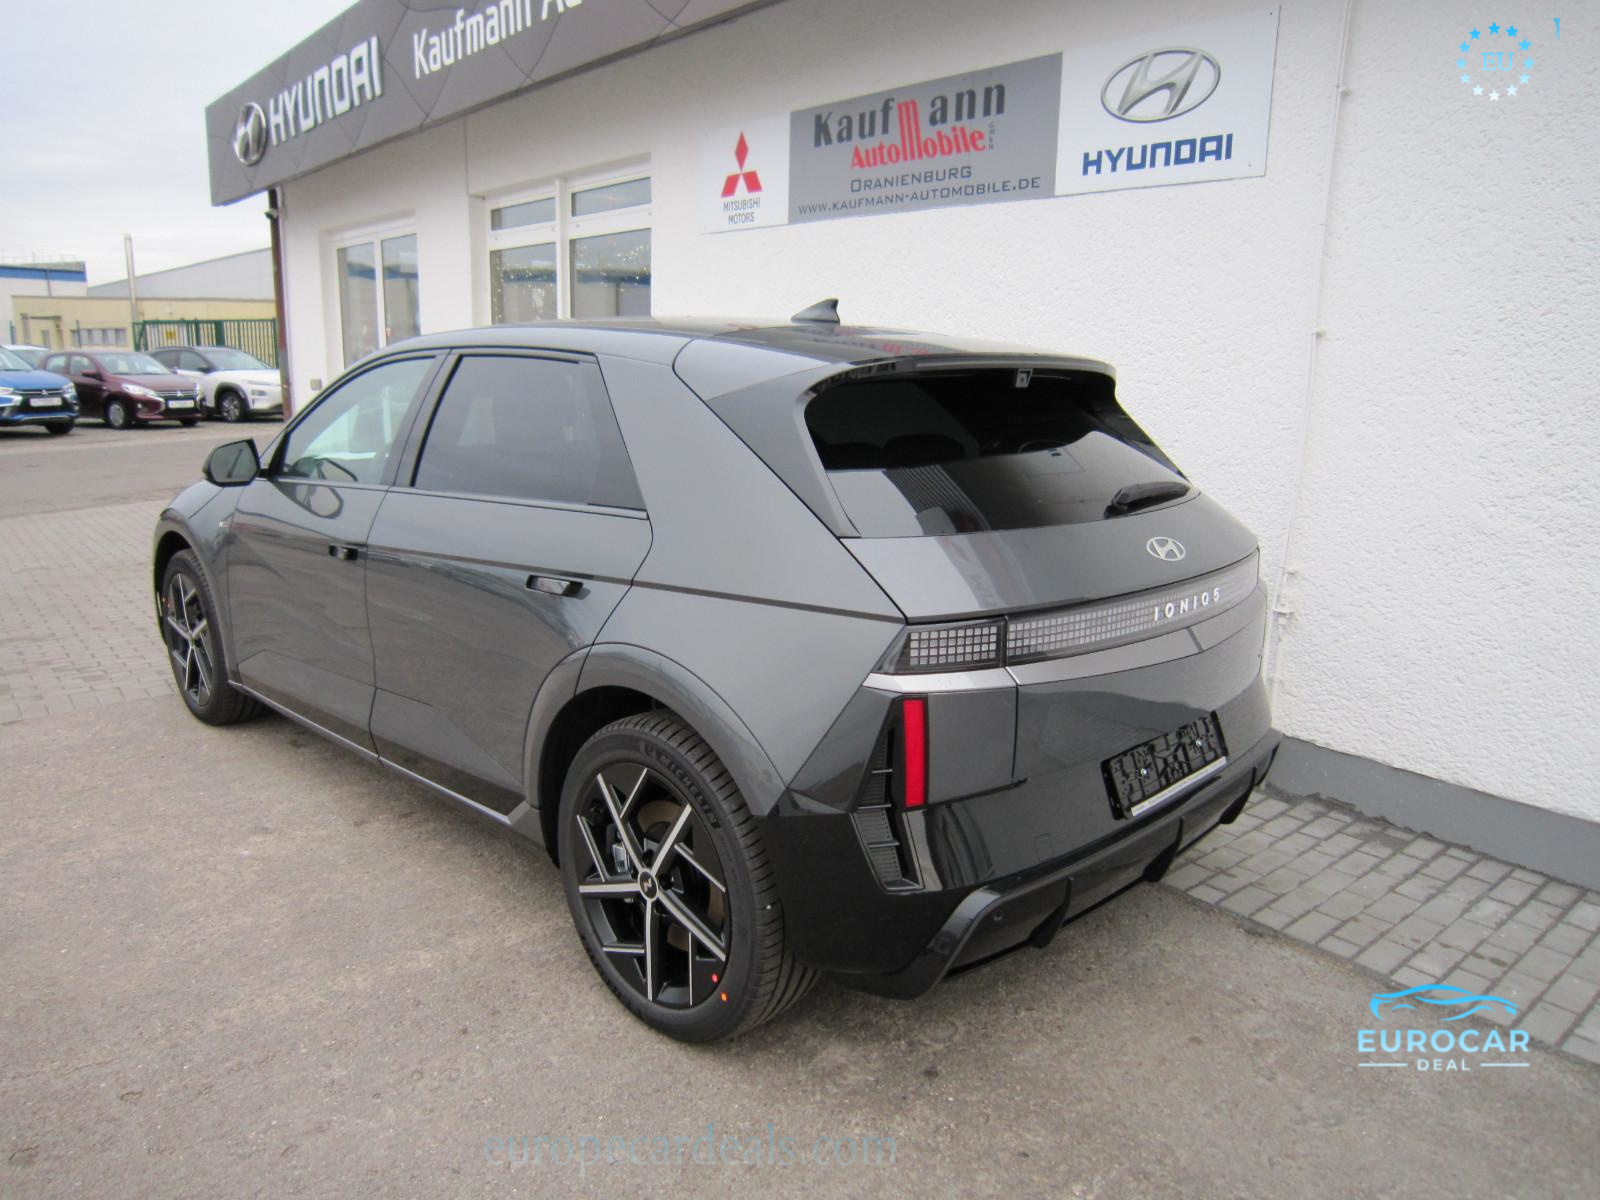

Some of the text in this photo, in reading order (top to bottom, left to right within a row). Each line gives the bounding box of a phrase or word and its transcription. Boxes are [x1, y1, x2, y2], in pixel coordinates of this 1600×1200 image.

[413, 0, 531, 79] Kaufmann
[270, 35, 382, 146] HYUNDAI
[1082, 133, 1233, 176] HYUNDAI
[850, 166, 973, 193] ORANIENBURG
[723, 197, 761, 212] MITSUBISHI
[728, 212, 755, 225] MOTORS
